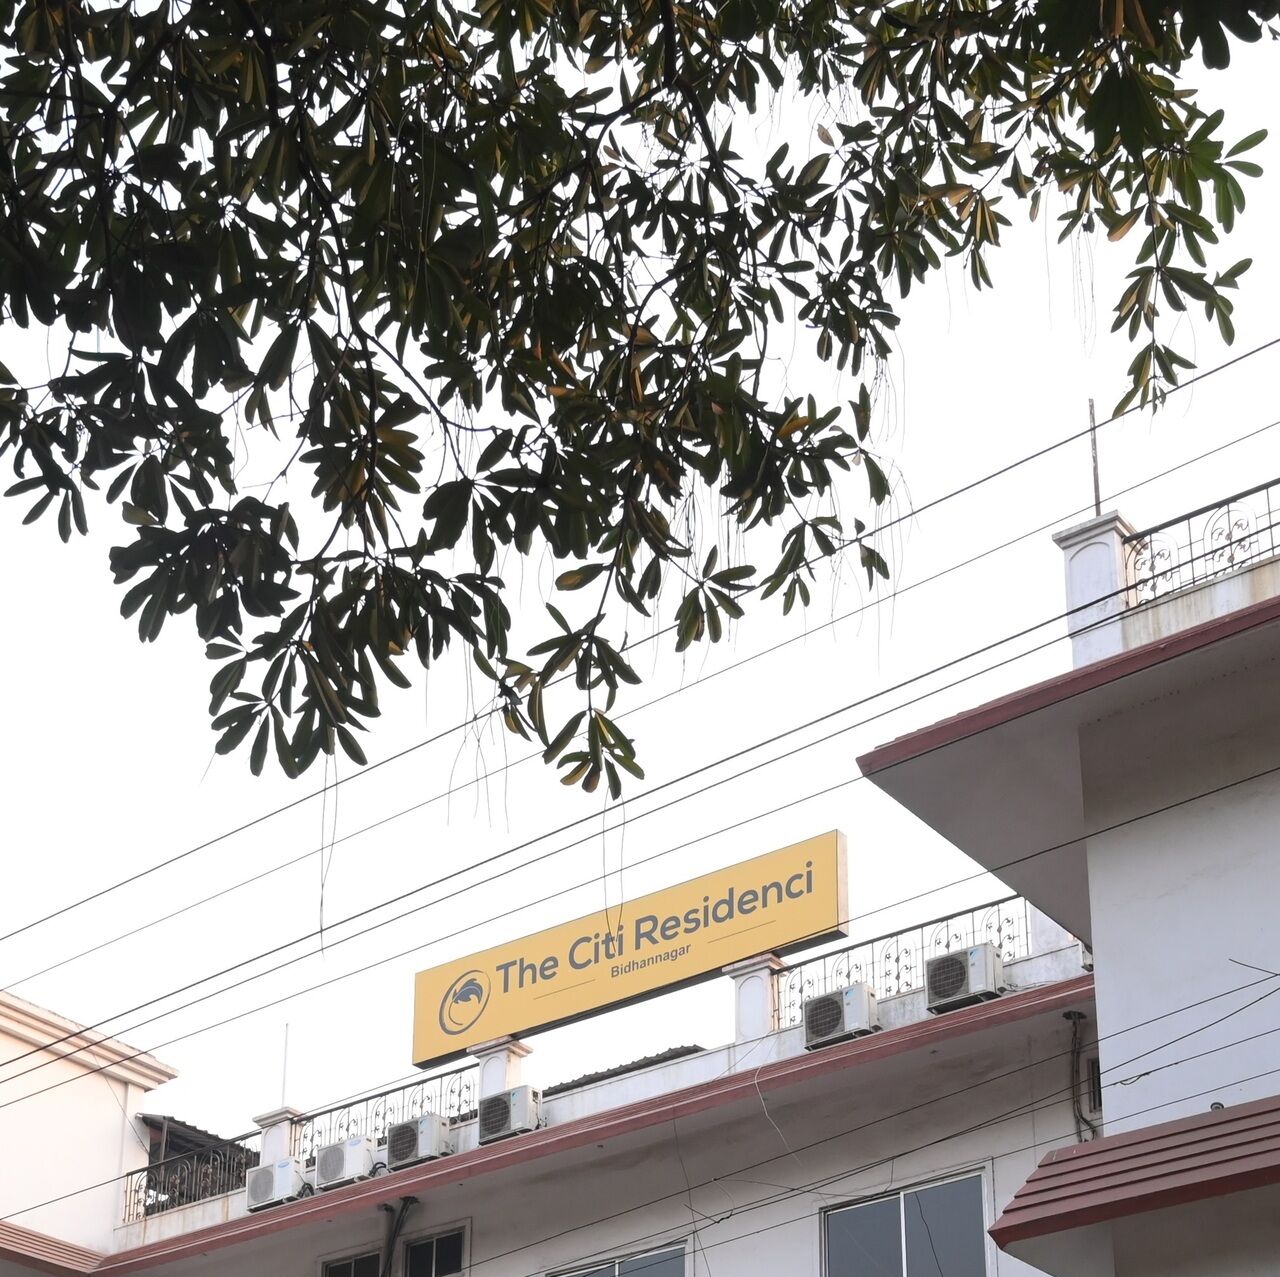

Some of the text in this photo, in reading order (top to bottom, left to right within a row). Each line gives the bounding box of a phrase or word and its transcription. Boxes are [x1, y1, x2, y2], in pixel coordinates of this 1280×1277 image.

[495, 860, 813, 994] The Citi Residenci
[611, 943, 692, 979] Bidhannagar
